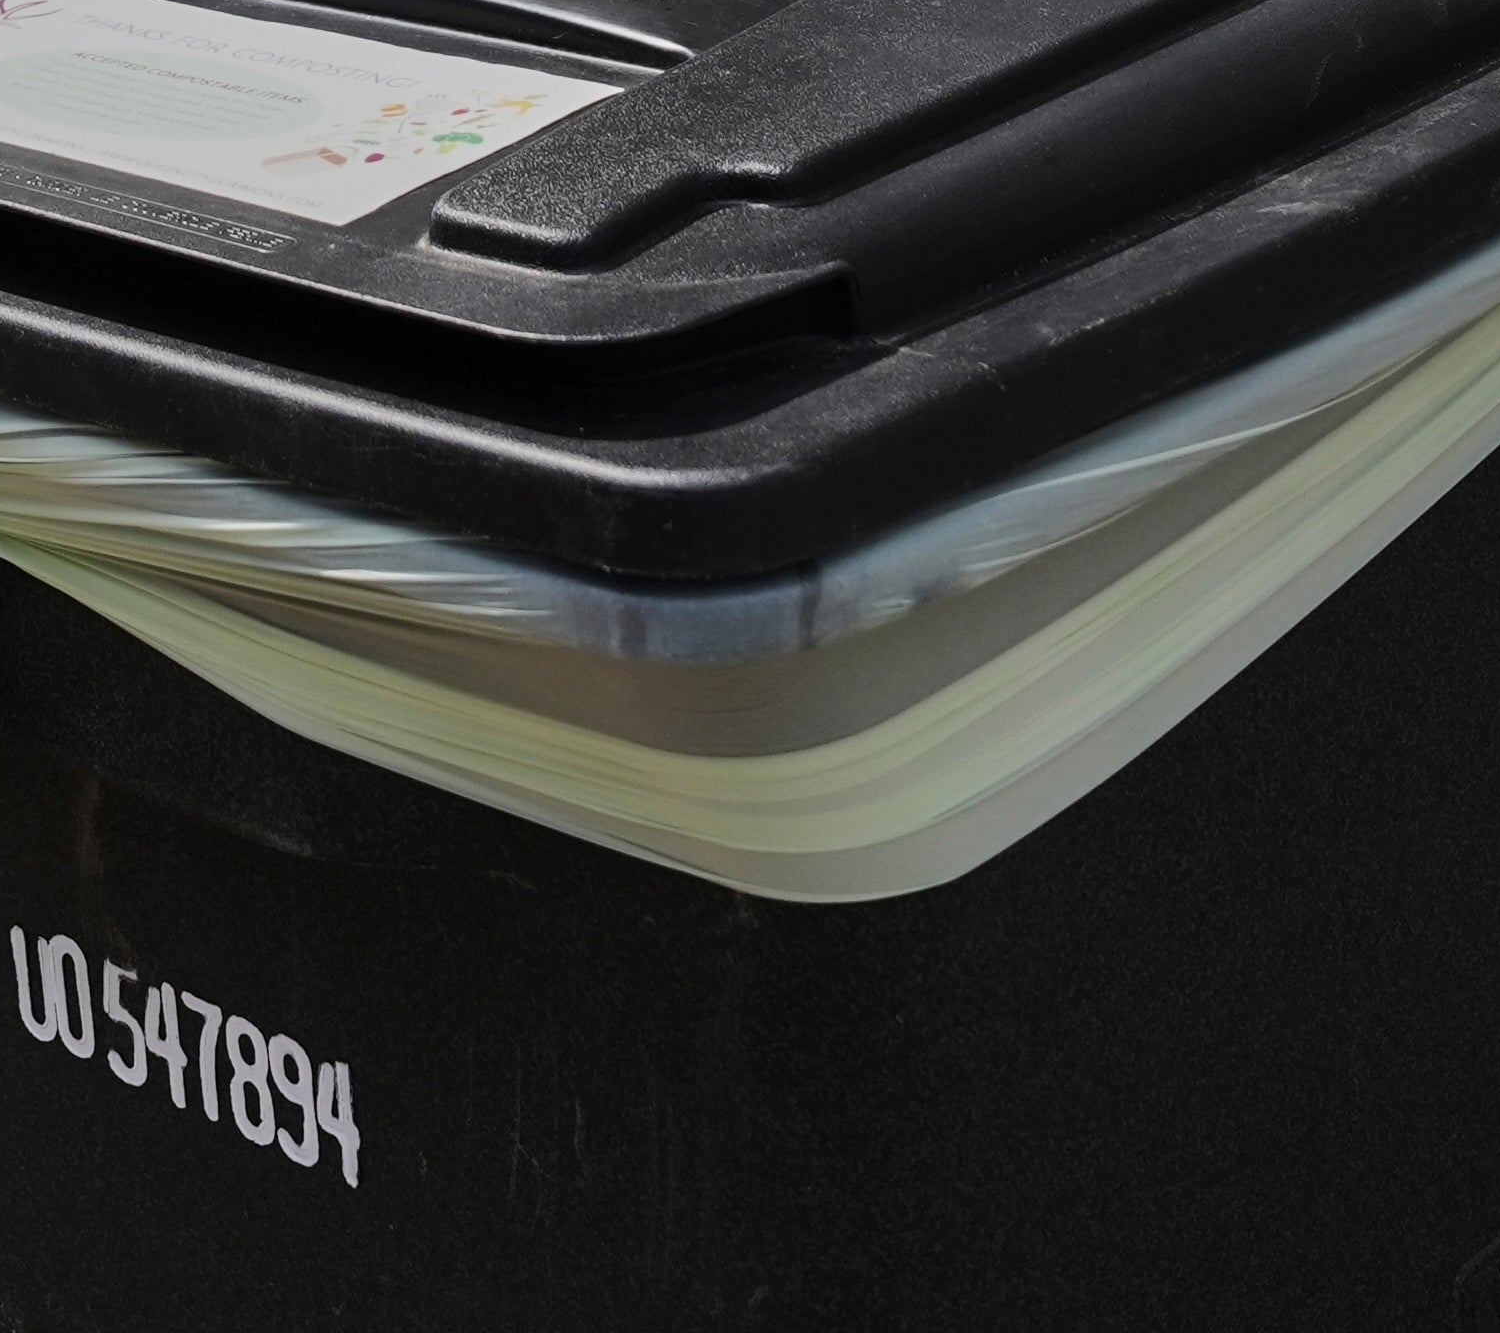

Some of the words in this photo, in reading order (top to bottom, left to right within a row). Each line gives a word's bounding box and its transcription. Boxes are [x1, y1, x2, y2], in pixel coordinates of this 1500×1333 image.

[73, 13, 172, 42] THANKS
[173, 35, 229, 54] FOR
[231, 46, 423, 90] COMPOSTING!
[73, 52, 147, 72] ACCEPTED
[147, 68, 257, 95] COMPOSTABLE
[257, 88, 307, 105] ITEMS
[102, 958, 360, 1189] 547894
